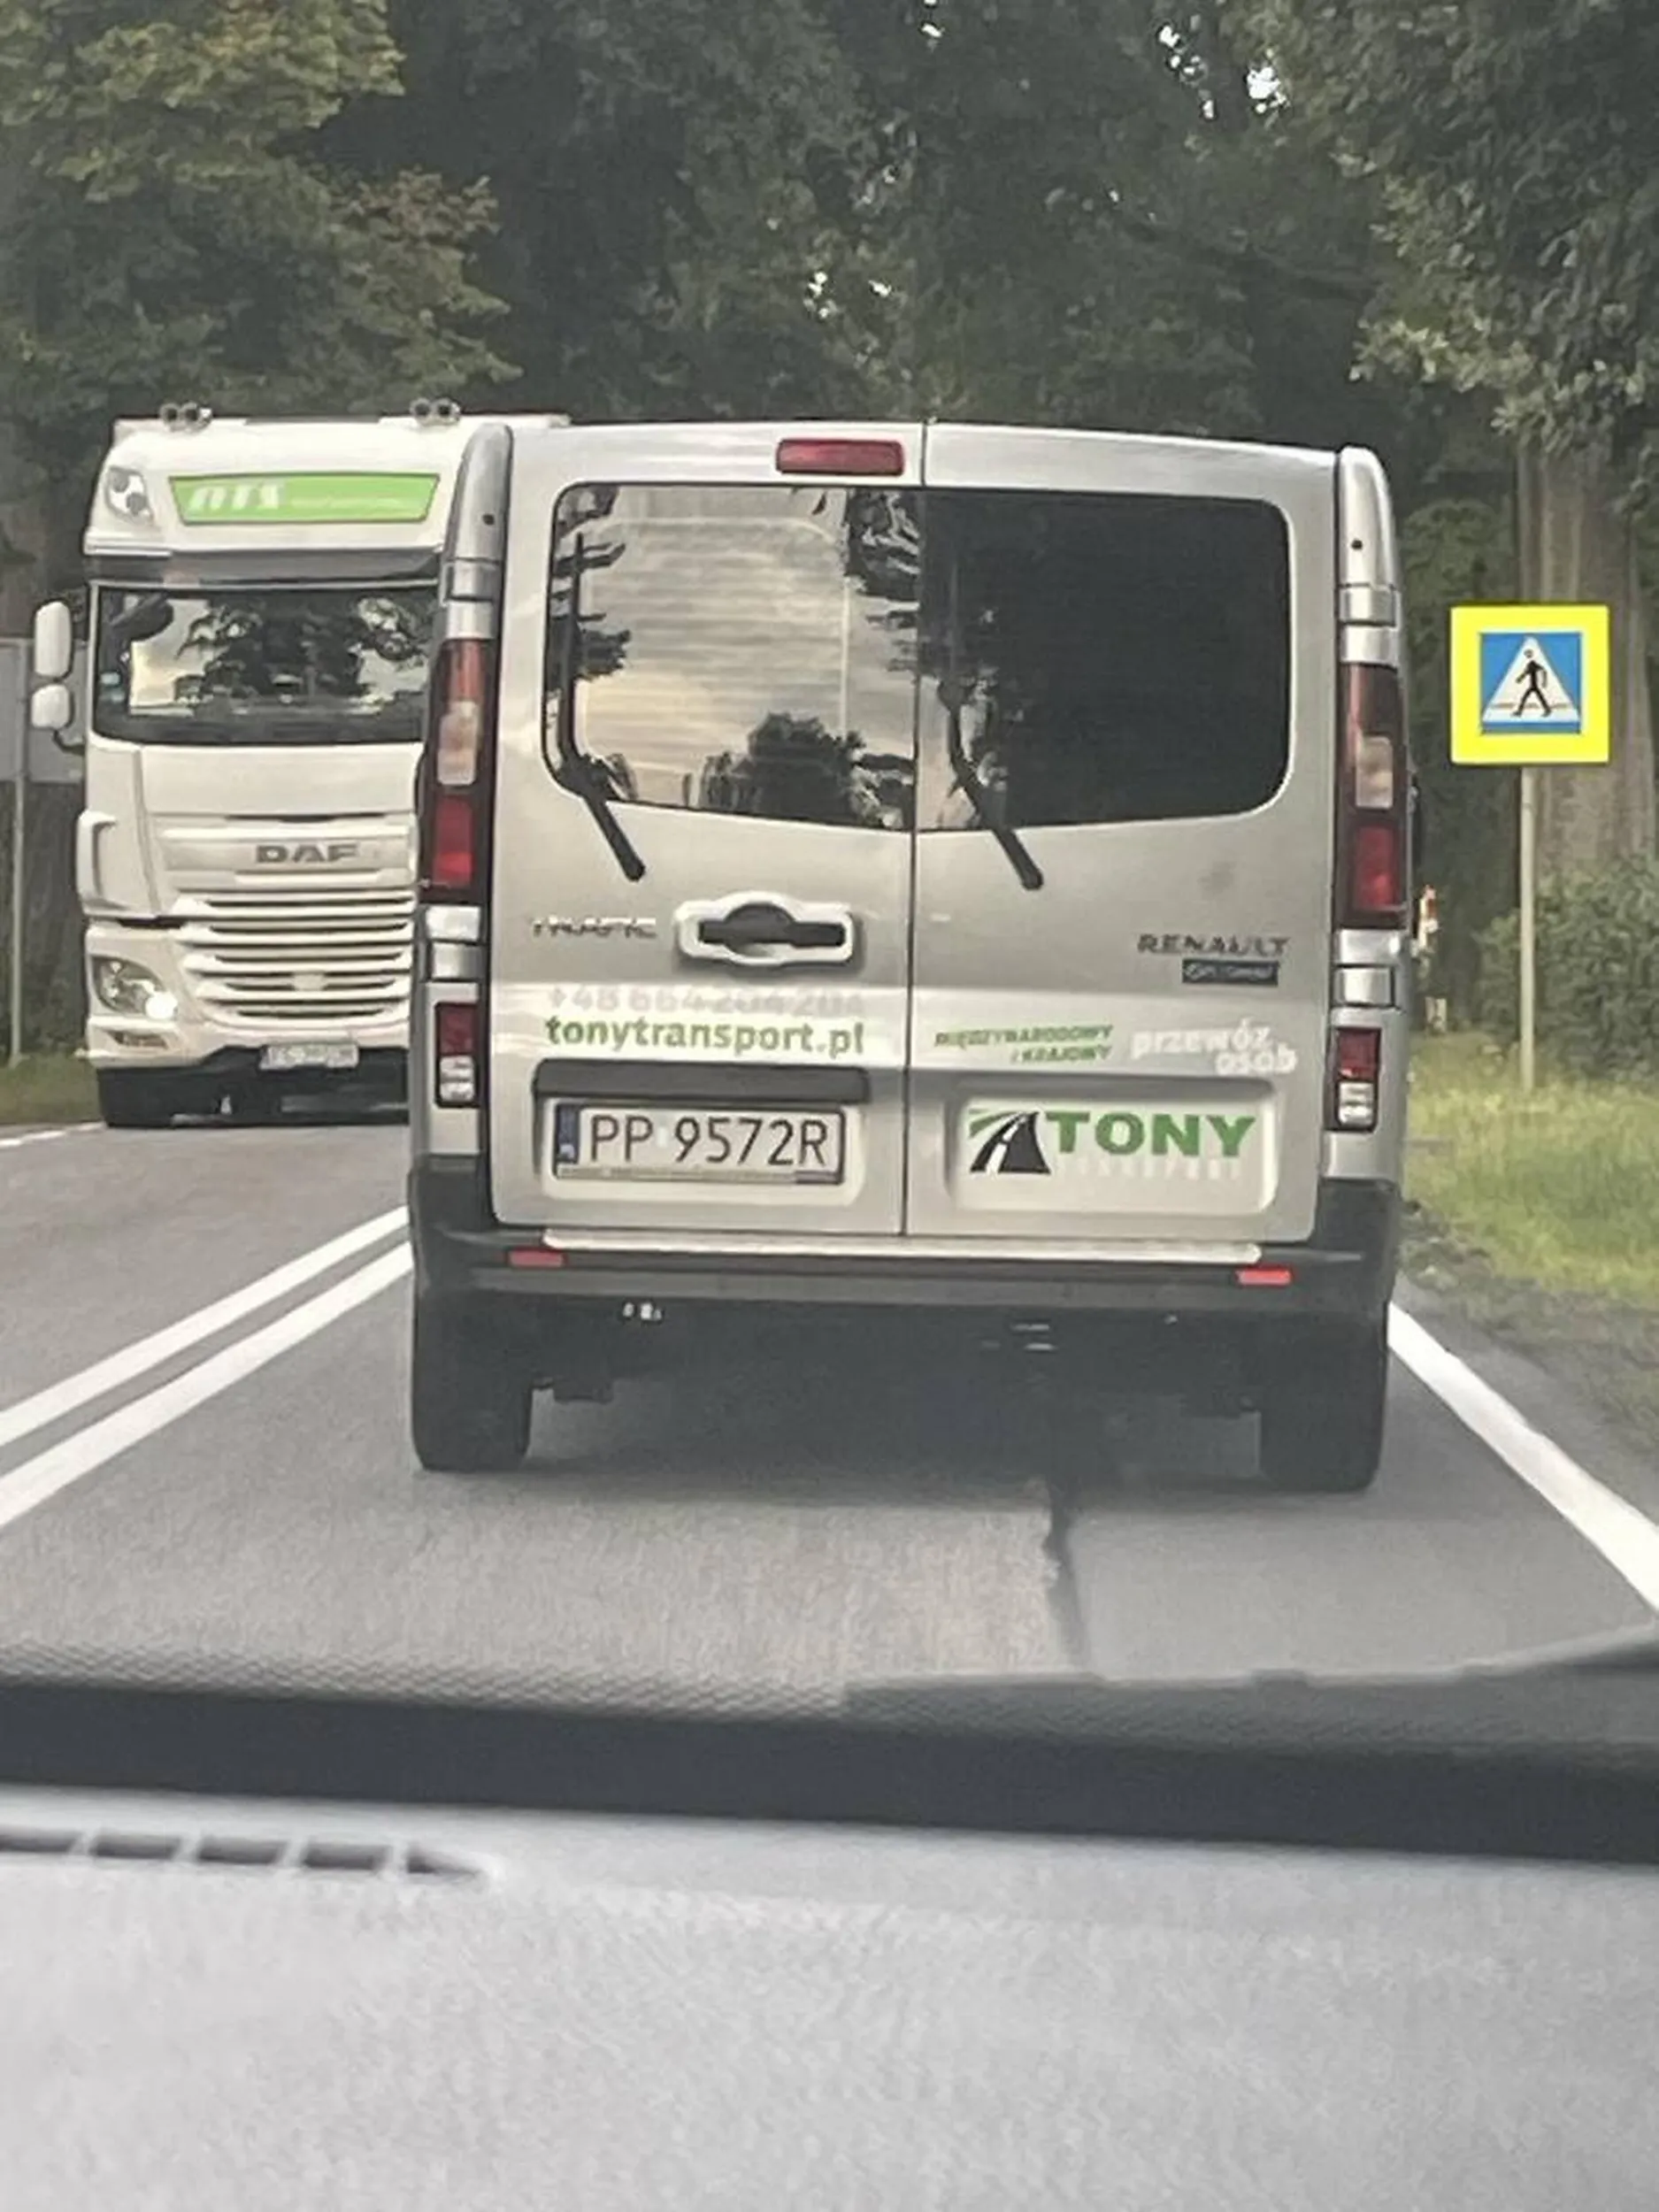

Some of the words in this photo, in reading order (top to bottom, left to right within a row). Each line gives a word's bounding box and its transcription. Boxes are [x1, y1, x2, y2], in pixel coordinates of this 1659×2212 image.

[256, 844, 358, 864] DAF
[1137, 933, 1291, 957] RENAULT
[544, 1015, 864, 1060] tonytransport.pl
[1131, 1018, 1271, 1060] przewóz
[590, 1114, 654, 1163] PP
[674, 1116, 828, 1166] 9572R
[1045, 1111, 1256, 1157] TONY
